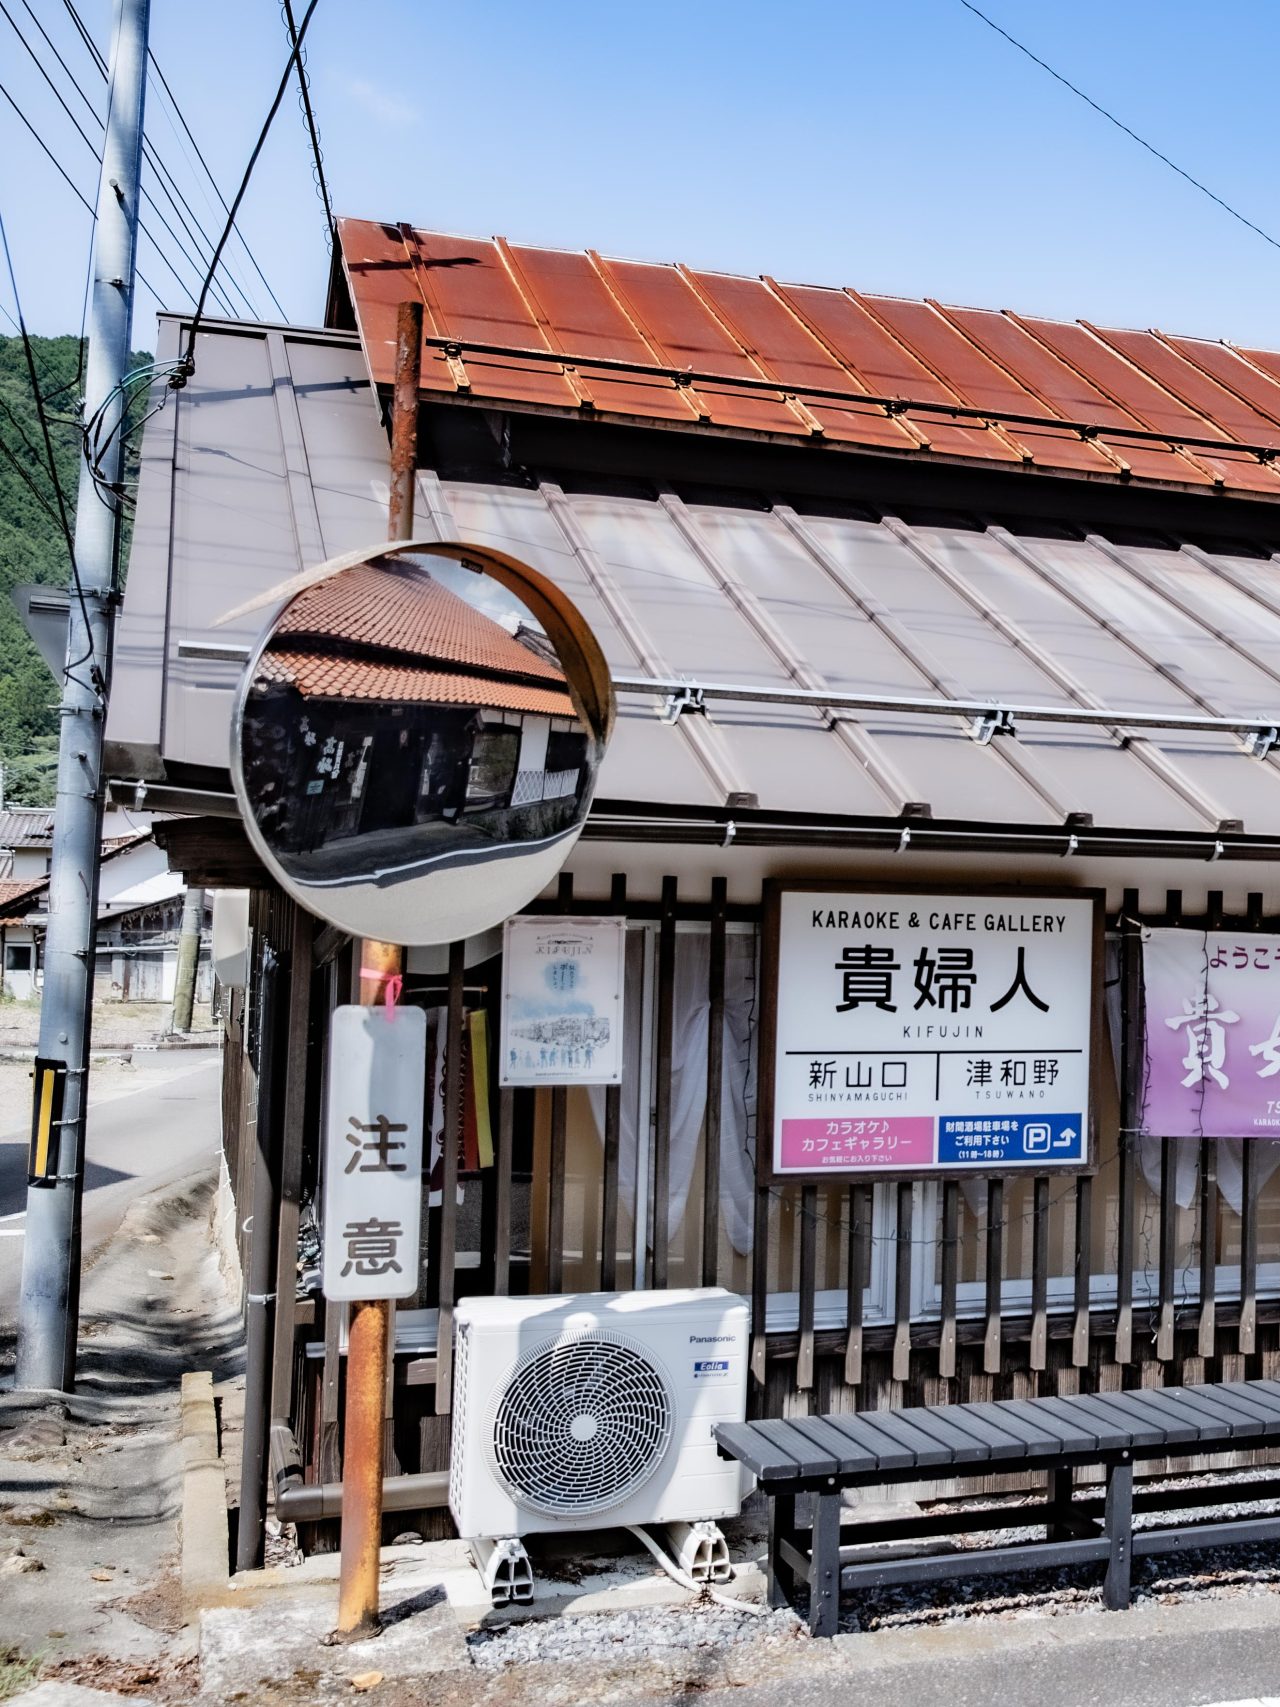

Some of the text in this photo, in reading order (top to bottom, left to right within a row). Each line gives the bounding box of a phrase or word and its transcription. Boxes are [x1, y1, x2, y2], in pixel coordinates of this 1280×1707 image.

[812, 910, 1066, 932] KARAOKE & CAFE GALLERY
[834, 944, 1050, 1014] 貴婦人
[903, 1025, 984, 1039] KIFUJIN
[809, 1060, 908, 1089] 新山口
[966, 1059, 1059, 1087] 津和野
[808, 1092, 908, 1102] SHINYAMAGUCHI
[975, 1090, 1045, 1100] TSUWANO
[801, 1136, 912, 1152] カフェギャラリー
[955, 1135, 1010, 1146] ご利用下さい
[340, 1114, 409, 1278] 注意
[689, 1334, 737, 1343] Panasonic
[700, 1362, 724, 1371] Eolia
